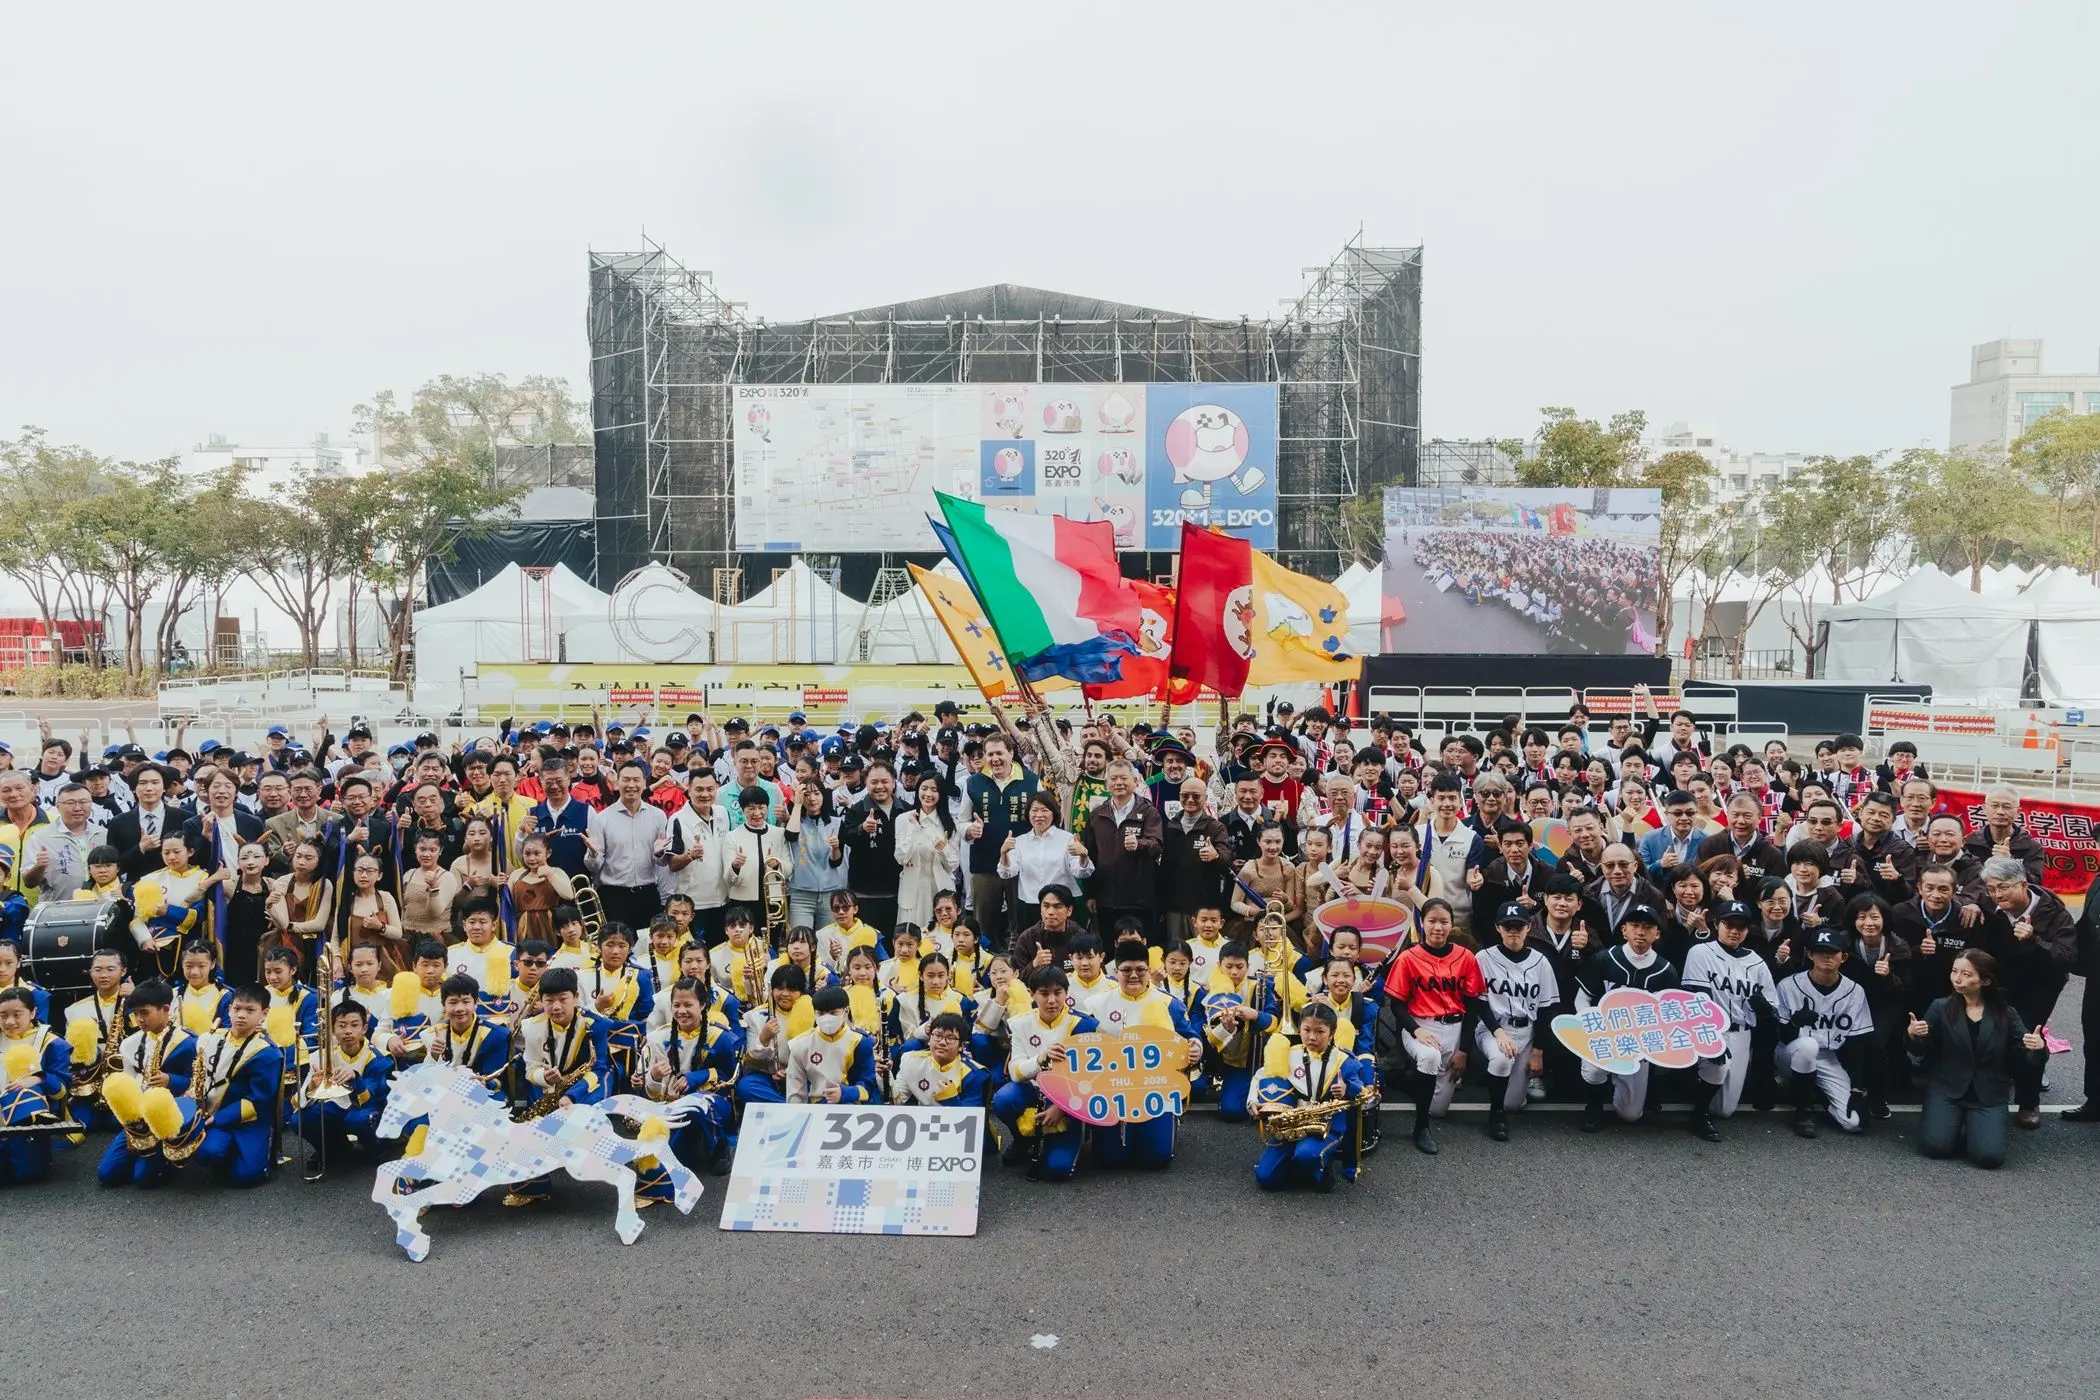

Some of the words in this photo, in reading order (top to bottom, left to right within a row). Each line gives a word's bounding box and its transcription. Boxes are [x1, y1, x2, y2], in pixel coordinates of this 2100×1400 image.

[739, 388, 766, 398] EXPO
[1045, 466, 1081, 478] EXPO
[1228, 509, 1273, 526] EXPO
[1967, 804, 2095, 840] 奈学園
[2033, 838, 2071, 850] UEN
[2075, 840, 2099, 850] UN
[1507, 906, 1518, 916] K
[1636, 904, 1649, 913] K
[1731, 902, 1743, 913] K
[1817, 932, 1831, 942] K
[1412, 975, 1467, 993] KANO
[1486, 977, 1540, 999] KANO
[1529, 1003, 1535, 1011] 5
[1582, 996, 1712, 1034] 我們嘉義式
[1079, 1034, 1102, 1043] 2025
[1123, 1032, 1142, 1041] FRI.
[1589, 1023, 1718, 1060] 管樂響全市
[1834, 1033, 1843, 1043] 4
[1065, 1044, 1161, 1073] 12.19
[1111, 1078, 1134, 1087] THU.
[1144, 1076, 1168, 1085] 2026
[1088, 1090, 1183, 1120] 01.01
[816, 1155, 874, 1170] 嘉義市
[907, 1156, 922, 1171] 博
[928, 1157, 976, 1171] EXPO
